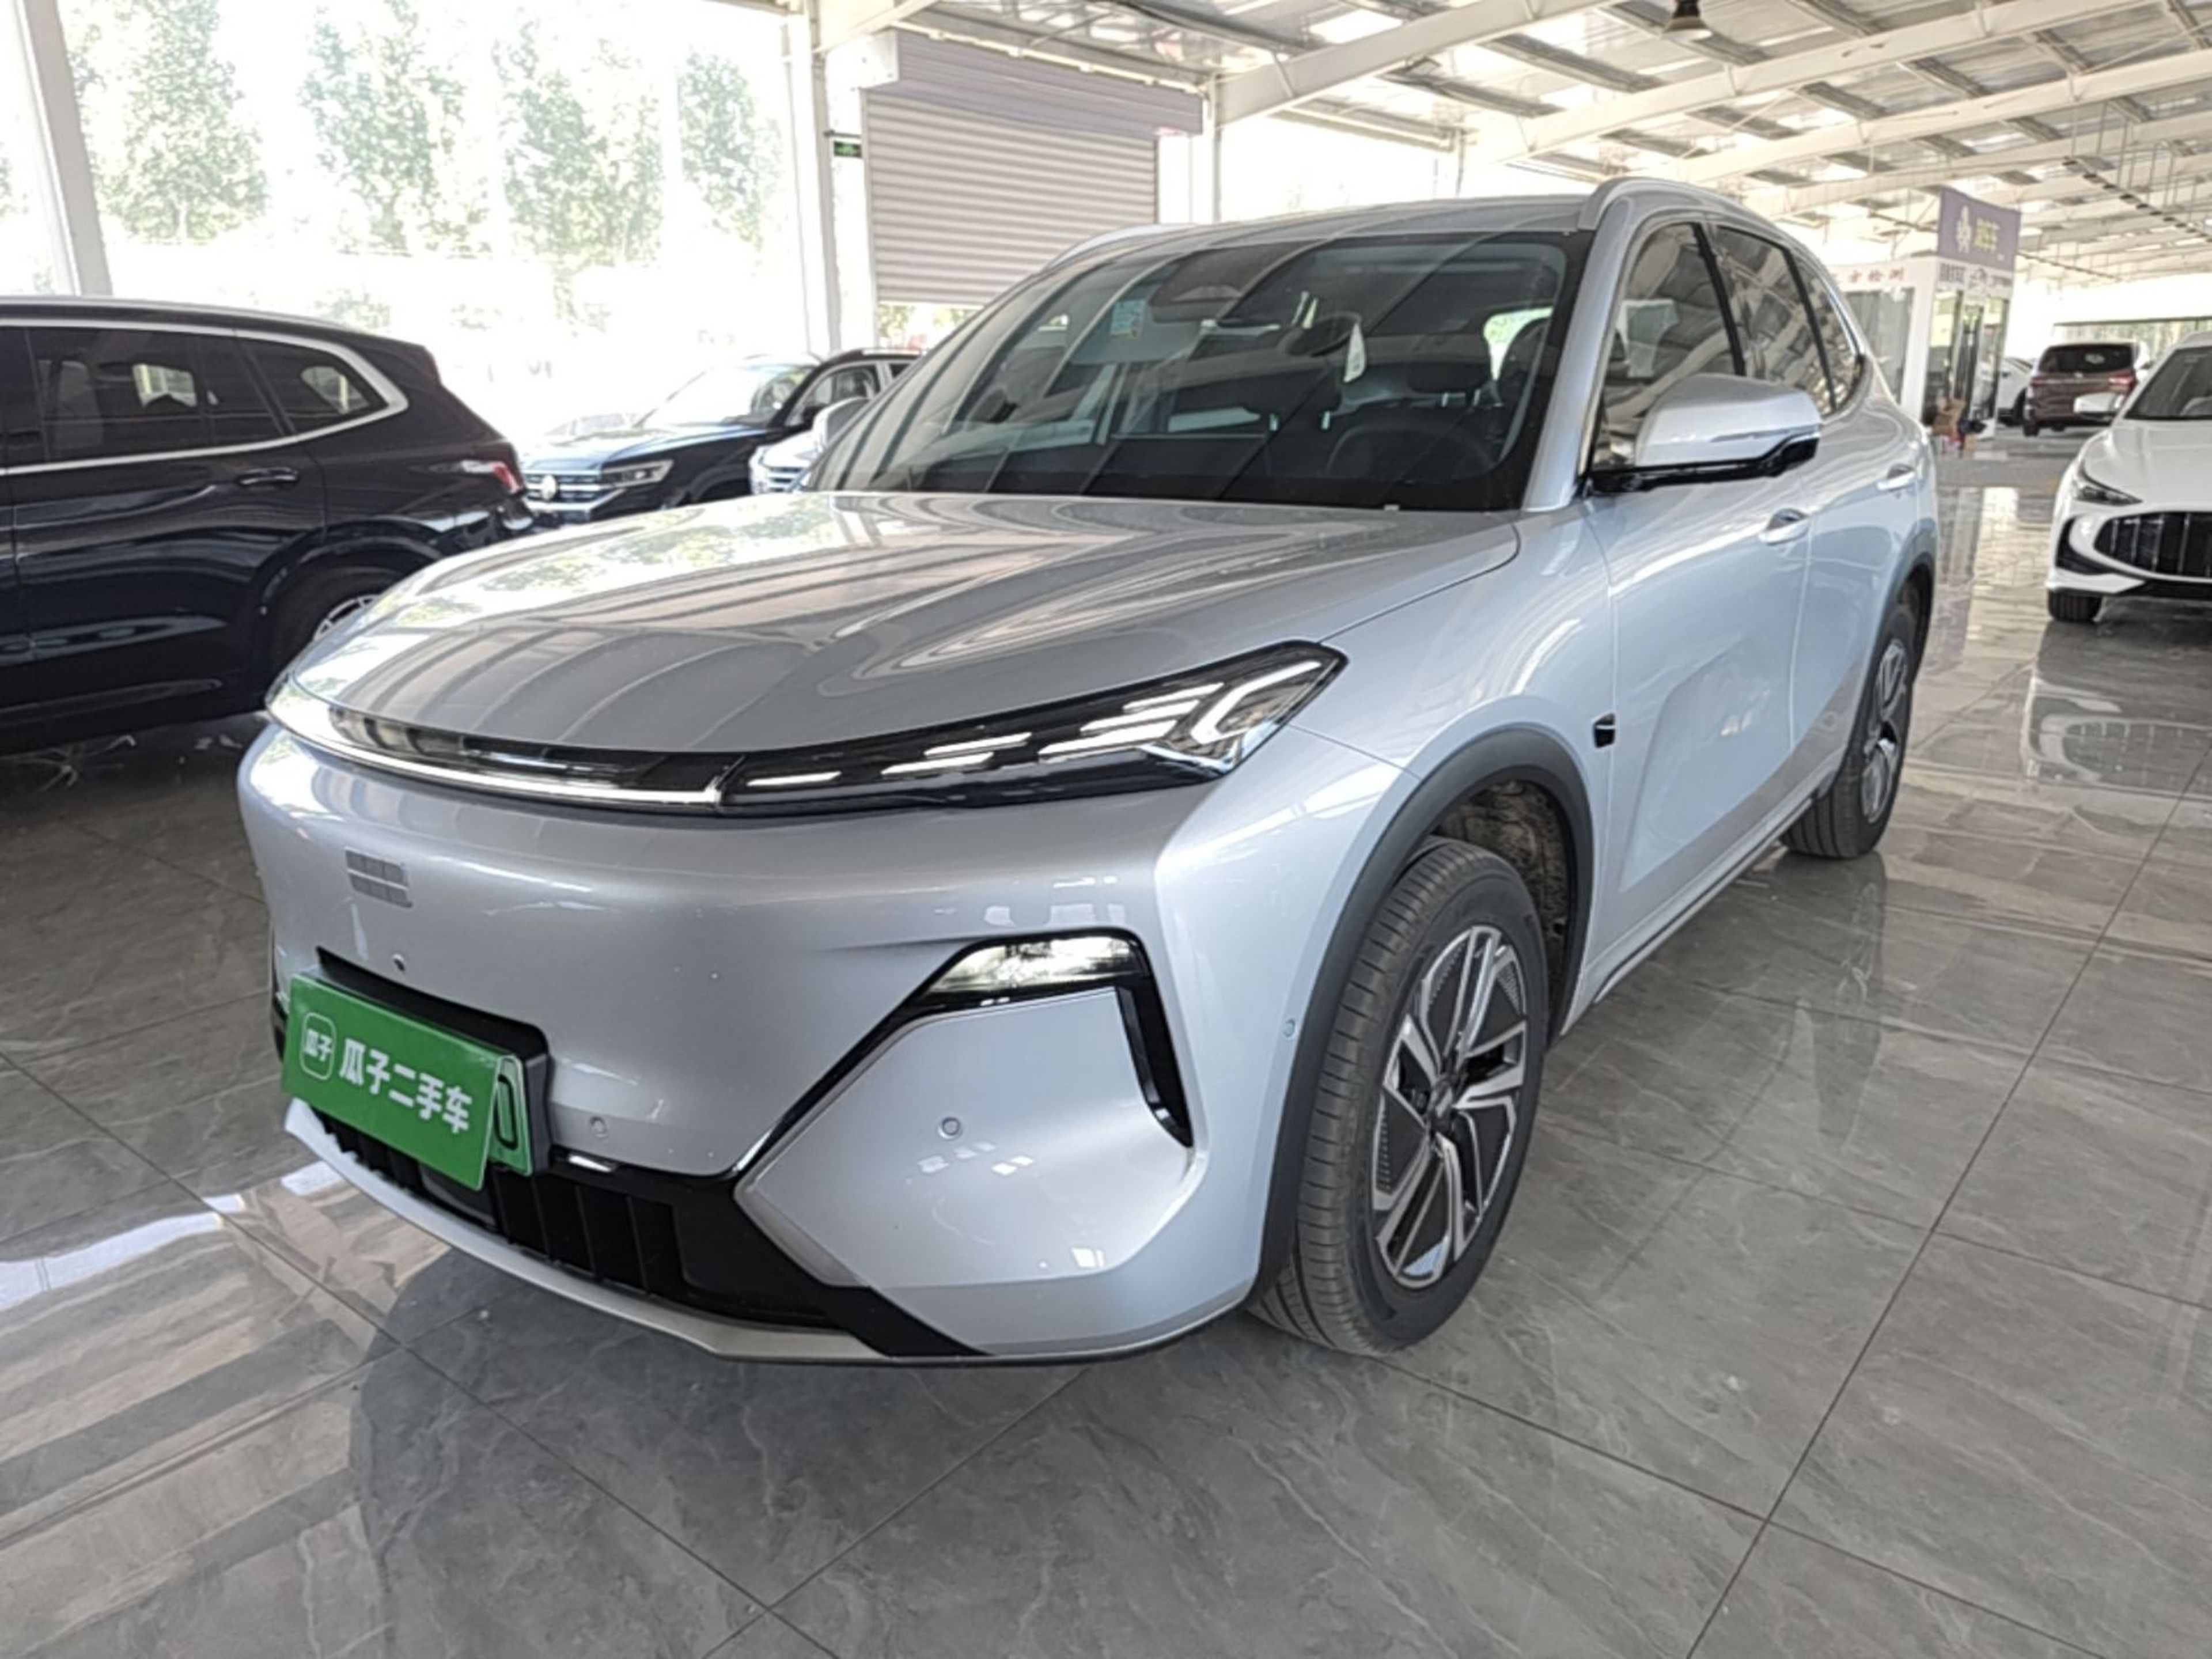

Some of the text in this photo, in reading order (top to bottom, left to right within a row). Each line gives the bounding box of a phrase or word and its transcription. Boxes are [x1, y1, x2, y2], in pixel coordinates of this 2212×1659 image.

[339, 1039, 472, 1133] 瓜子二手车
